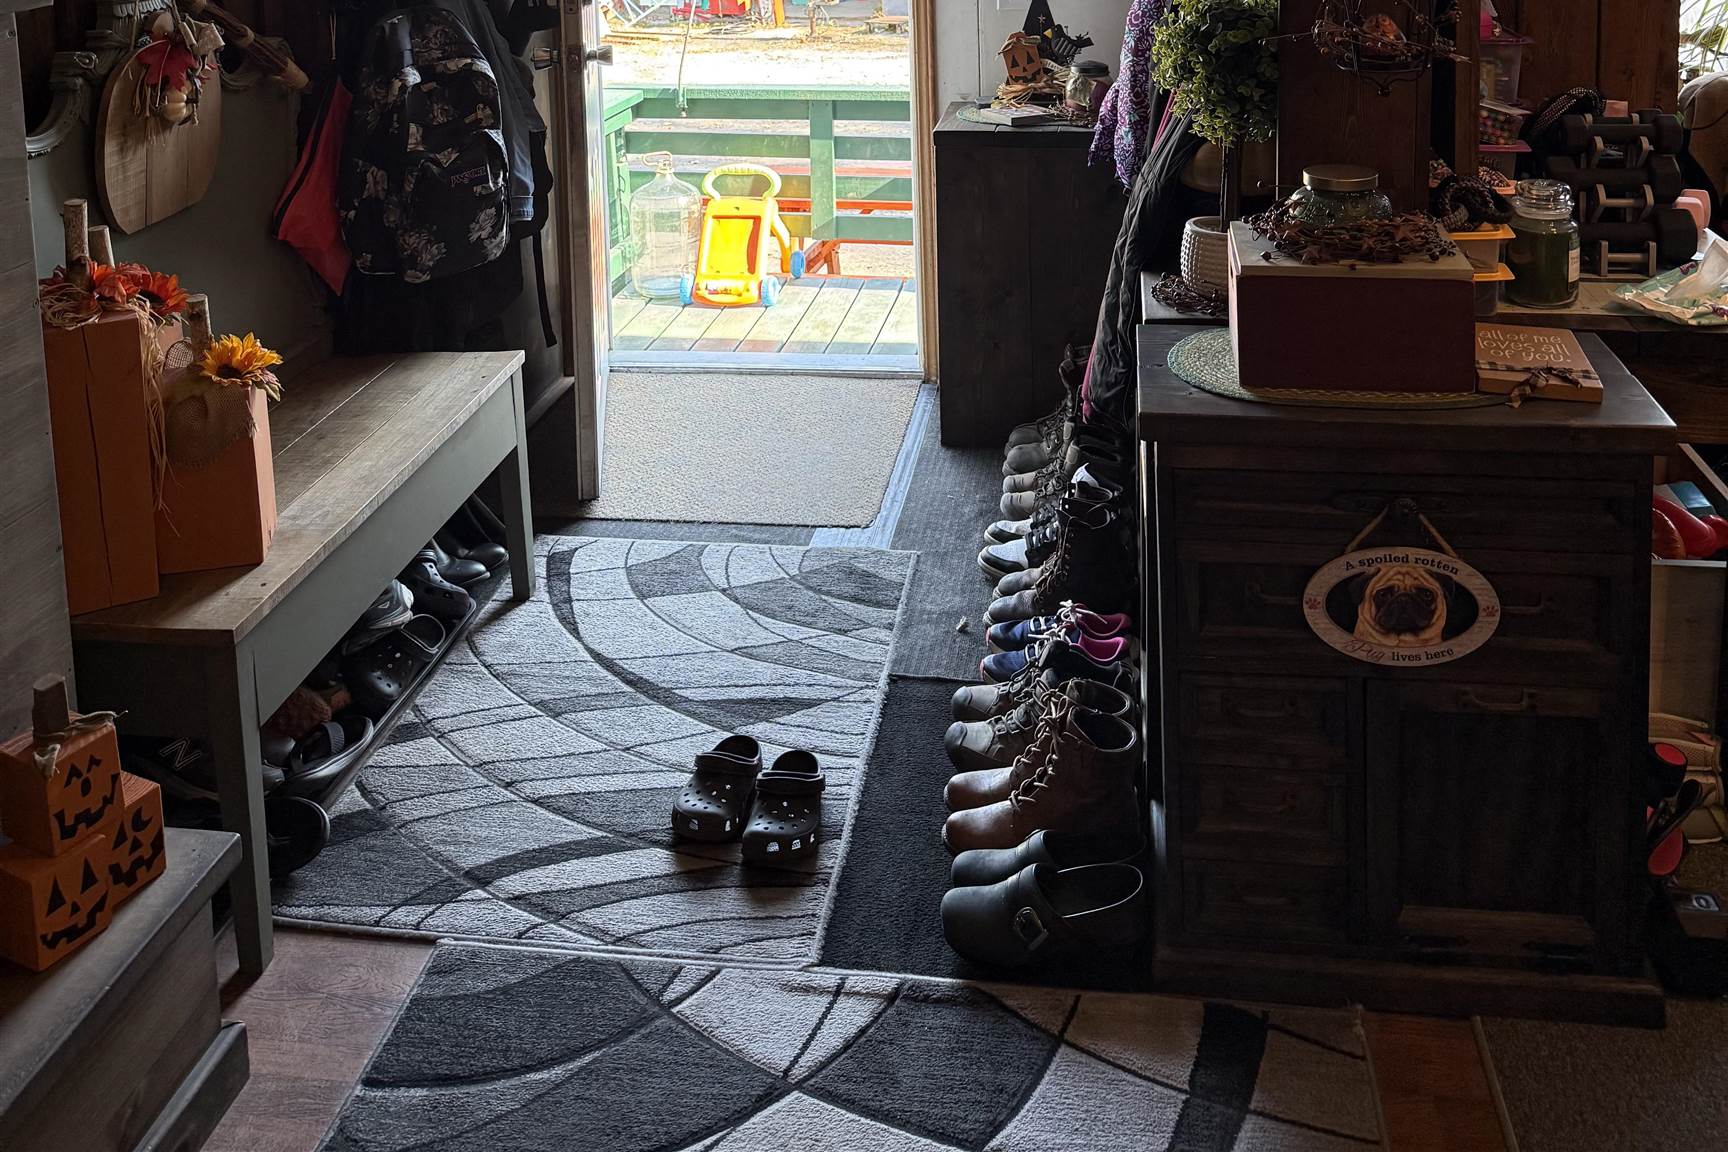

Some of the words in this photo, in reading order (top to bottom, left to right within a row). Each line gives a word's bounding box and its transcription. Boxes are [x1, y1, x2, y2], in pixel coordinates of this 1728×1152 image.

[1479, 330, 1504, 341] all
[1506, 333, 1528, 342] of
[1533, 335, 1561, 344] me
[1478, 337, 1535, 352] loves
[1541, 343, 1571, 356] all
[1490, 348, 1515, 359] of
[1344, 559, 1355, 571] A
[1358, 554, 1410, 568] spoiled
[1414, 556, 1459, 576] rotten
[1392, 651, 1422, 663] lives
[1426, 648, 1454, 660] here
